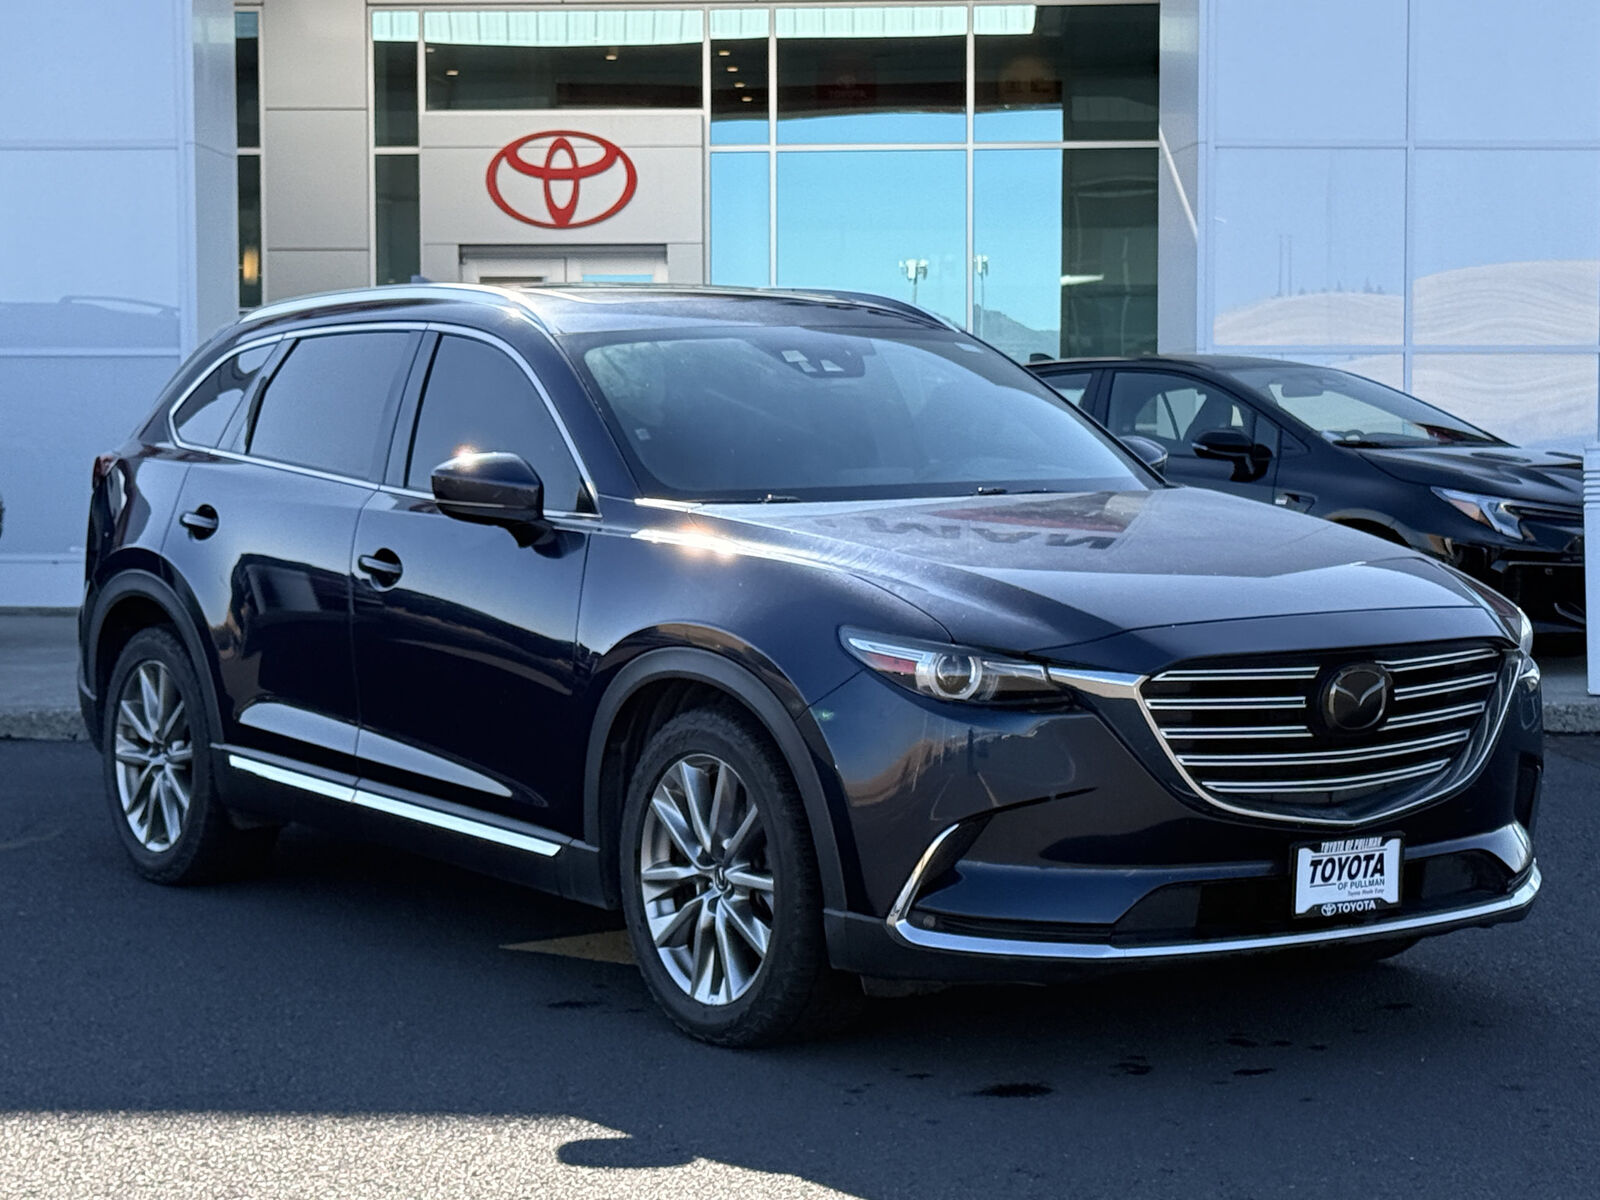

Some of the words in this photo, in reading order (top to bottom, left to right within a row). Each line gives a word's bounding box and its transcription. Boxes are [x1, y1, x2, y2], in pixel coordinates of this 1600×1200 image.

[1310, 853, 1384, 884] TOYOTA
[1337, 881, 1348, 891] OF
[1350, 879, 1384, 889] PULLMAN
[1337, 900, 1376, 912] TOYOTA
